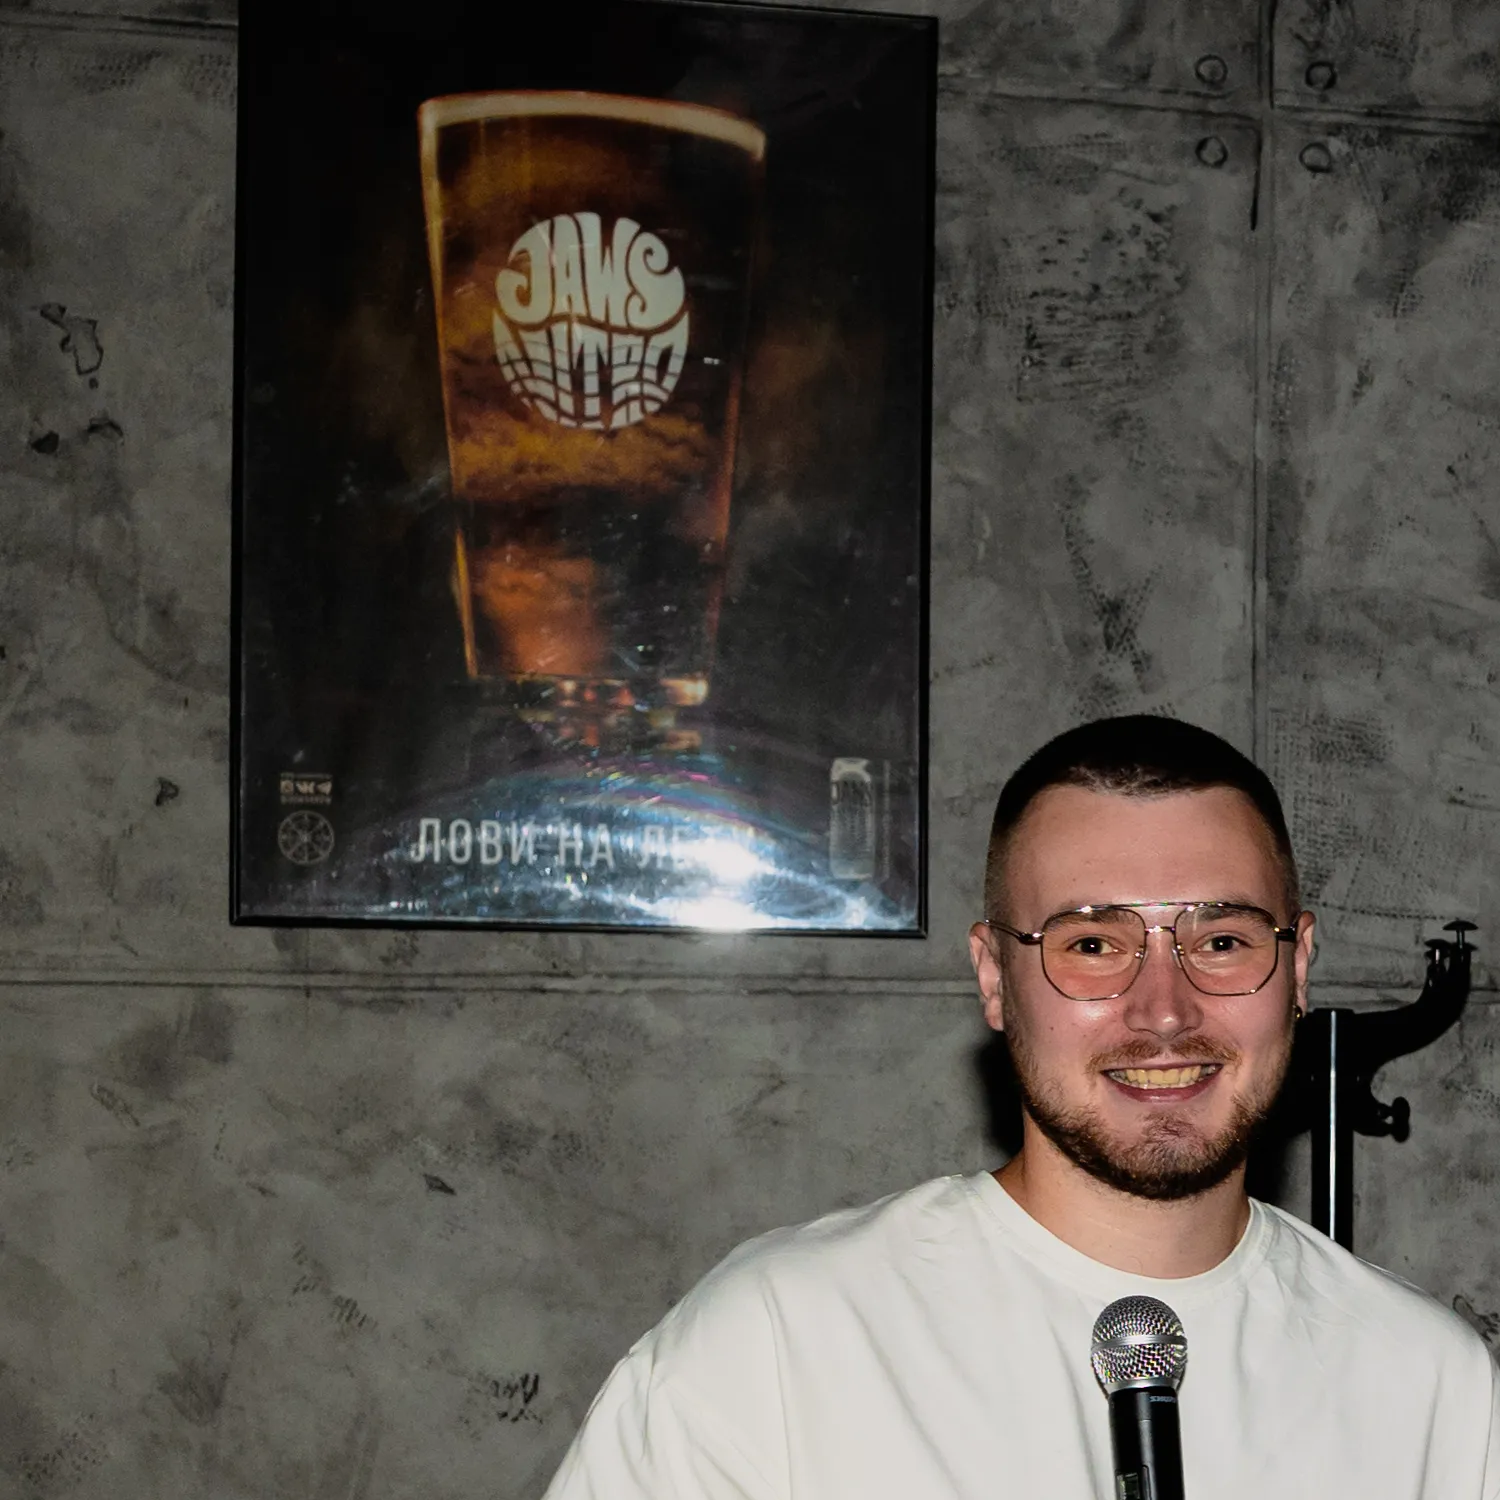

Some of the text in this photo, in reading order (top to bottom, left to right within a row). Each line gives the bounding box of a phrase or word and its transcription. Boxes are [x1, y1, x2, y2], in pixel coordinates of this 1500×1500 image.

[495, 212, 685, 330] JAWS
[411, 818, 534, 866] ЛОВИ
[559, 822, 614, 868] НА
